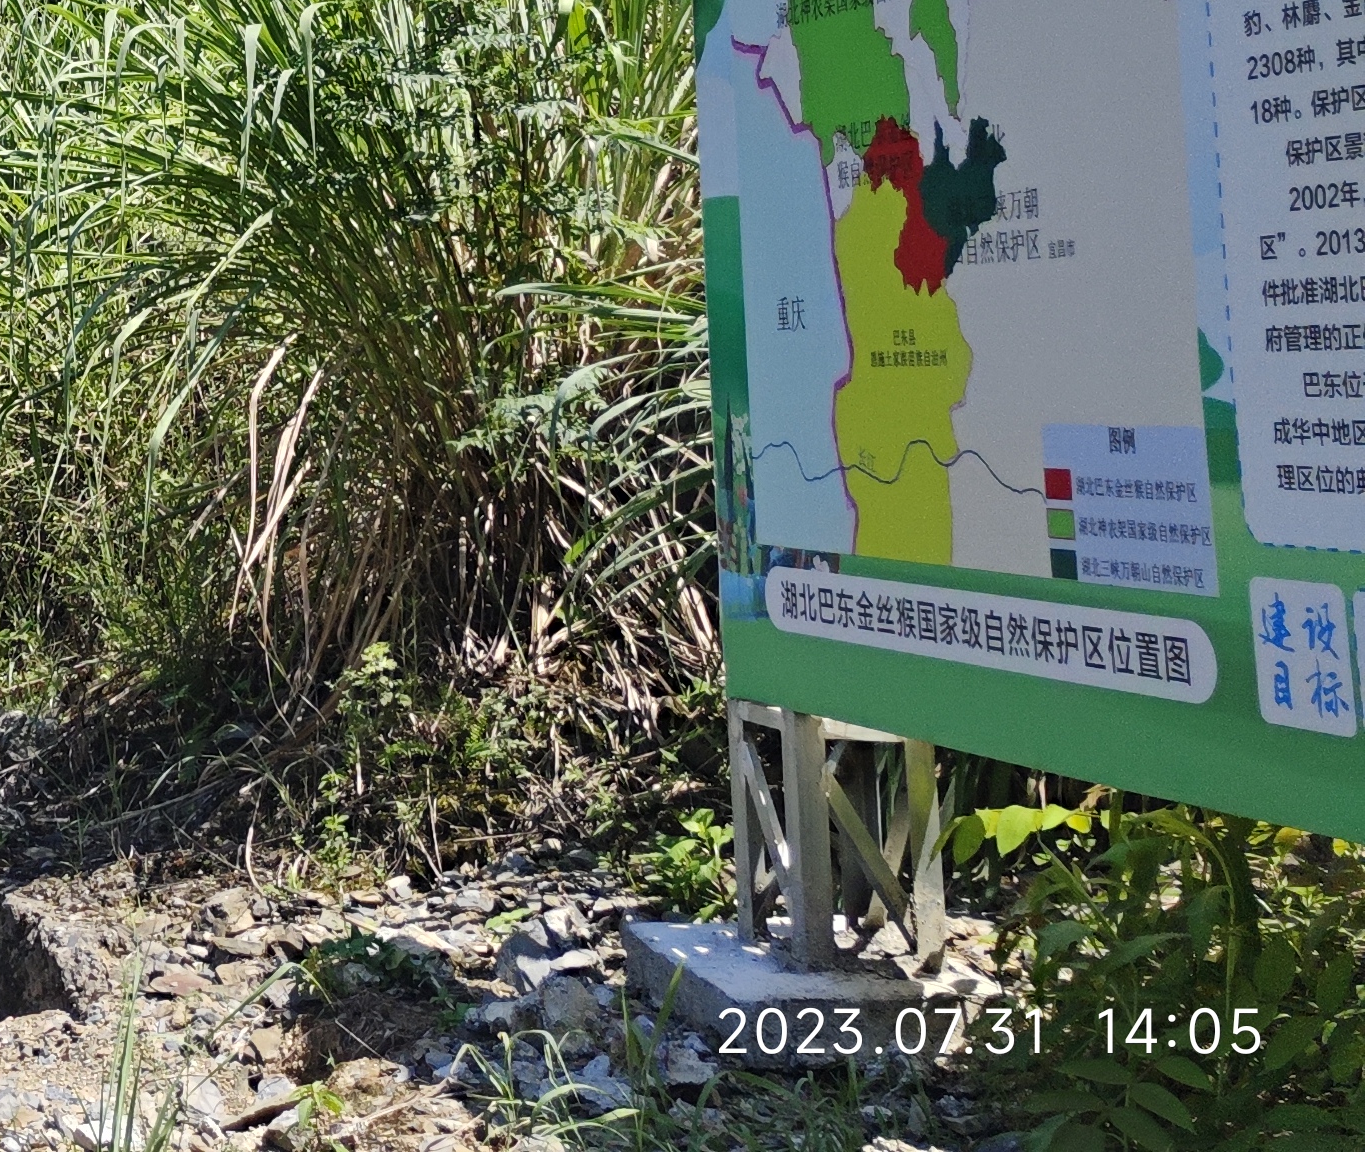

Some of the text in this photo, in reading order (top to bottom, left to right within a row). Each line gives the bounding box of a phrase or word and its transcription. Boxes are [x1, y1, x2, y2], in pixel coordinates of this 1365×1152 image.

[1285, 131, 1365, 167] 保护区景
[1289, 180, 1365, 212] 2002年
[957, 228, 1042, 266] 自然保护区
[776, 295, 807, 333] 重庆
[892, 328, 917, 347] 巴东县
[1265, 324, 1365, 353] 府管理的正
[1302, 370, 1365, 400] 巴东位
[1108, 426, 1137, 455] 图例
[1076, 475, 1198, 503] 湖北巴东金丝猴自然保护区
[1078, 516, 1212, 546] 湖北神农架国家级自然保护区
[1081, 556, 1205, 589] 湖北三峡万朝山自然保护区
[779, 579, 1193, 686] 湖北巴东金丝猴国家级自然保护区位置图
[1258, 591, 1341, 660] 建设
[1273, 659, 1350, 719] 目标
